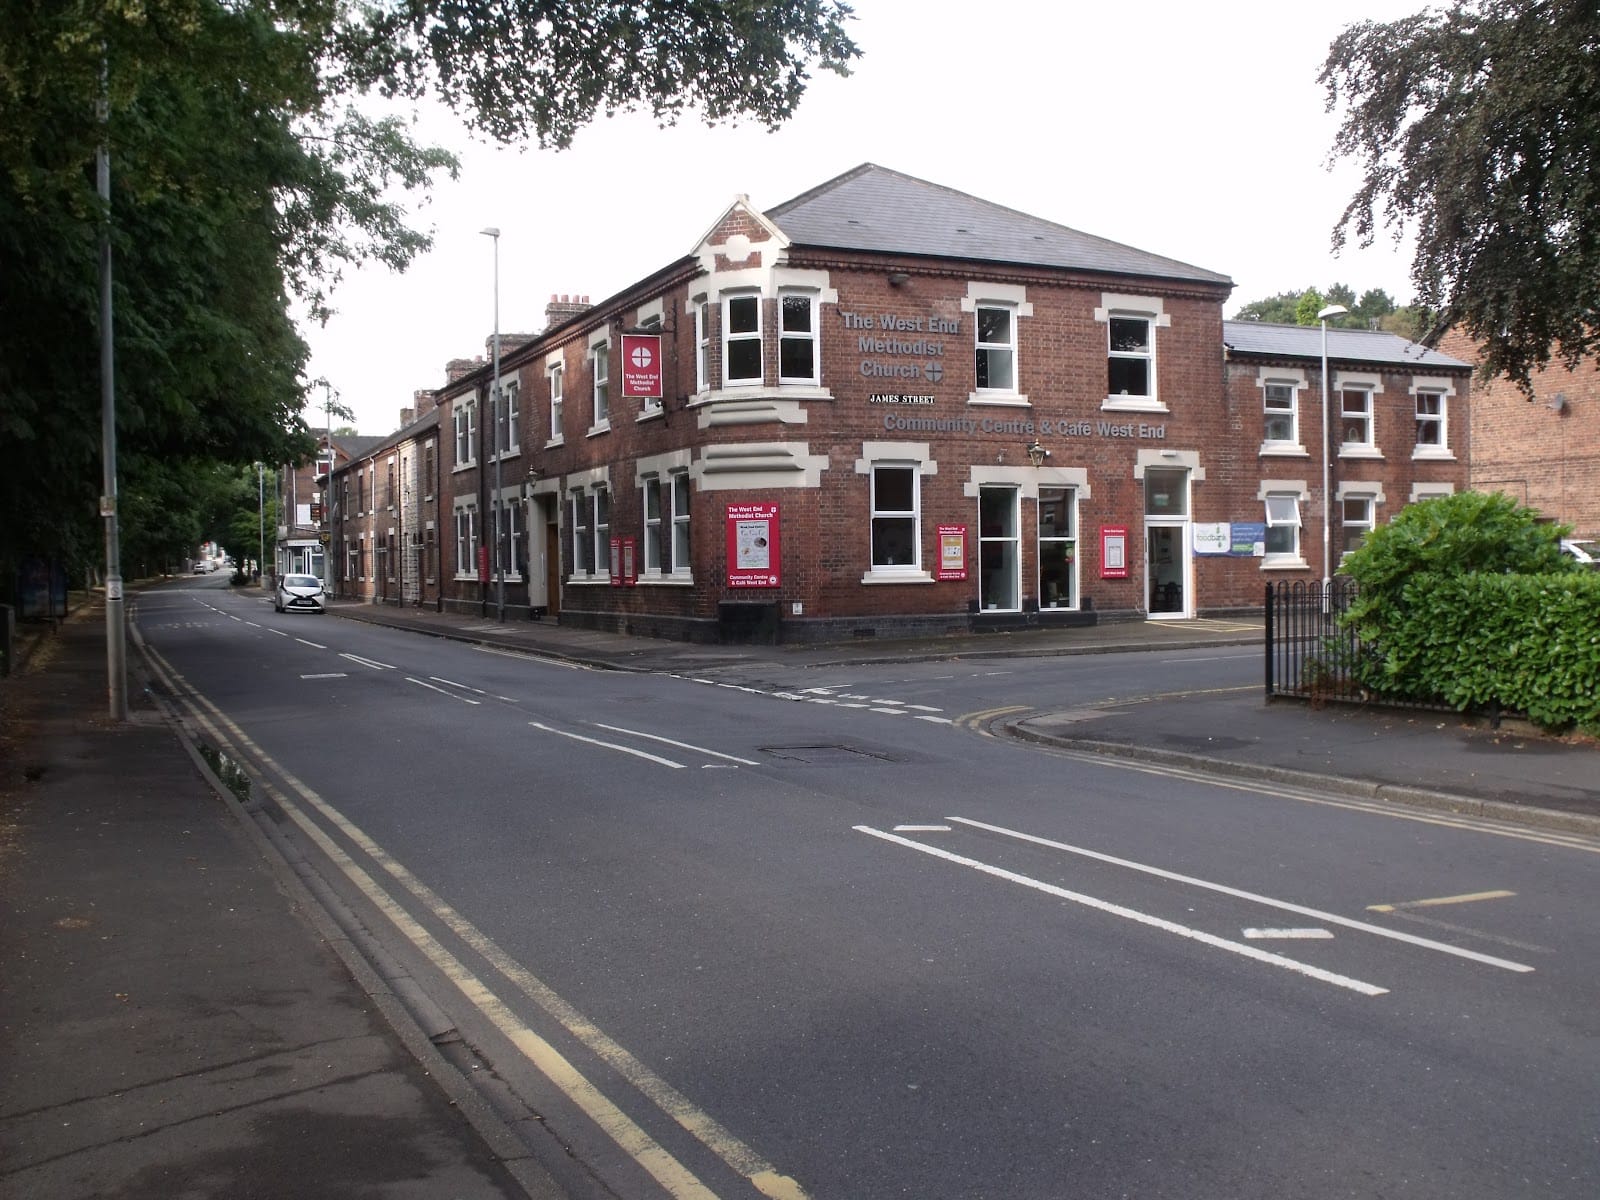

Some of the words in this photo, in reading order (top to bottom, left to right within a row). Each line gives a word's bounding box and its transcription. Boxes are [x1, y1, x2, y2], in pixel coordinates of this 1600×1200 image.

[841, 311, 874, 329] The
[880, 314, 923, 332] West
[928, 317, 960, 334] End
[858, 336, 945, 356] Methodist
[860, 360, 921, 378] Church
[870, 394, 900, 403] JAMES
[902, 395, 935, 404] STREET
[883, 413, 977, 435] Community
[981, 417, 1034, 434] Centre
[1039, 420, 1053, 435] &
[1057, 420, 1092, 436] Café
[1096, 421, 1135, 437] West
[1139, 423, 1165, 439] End
